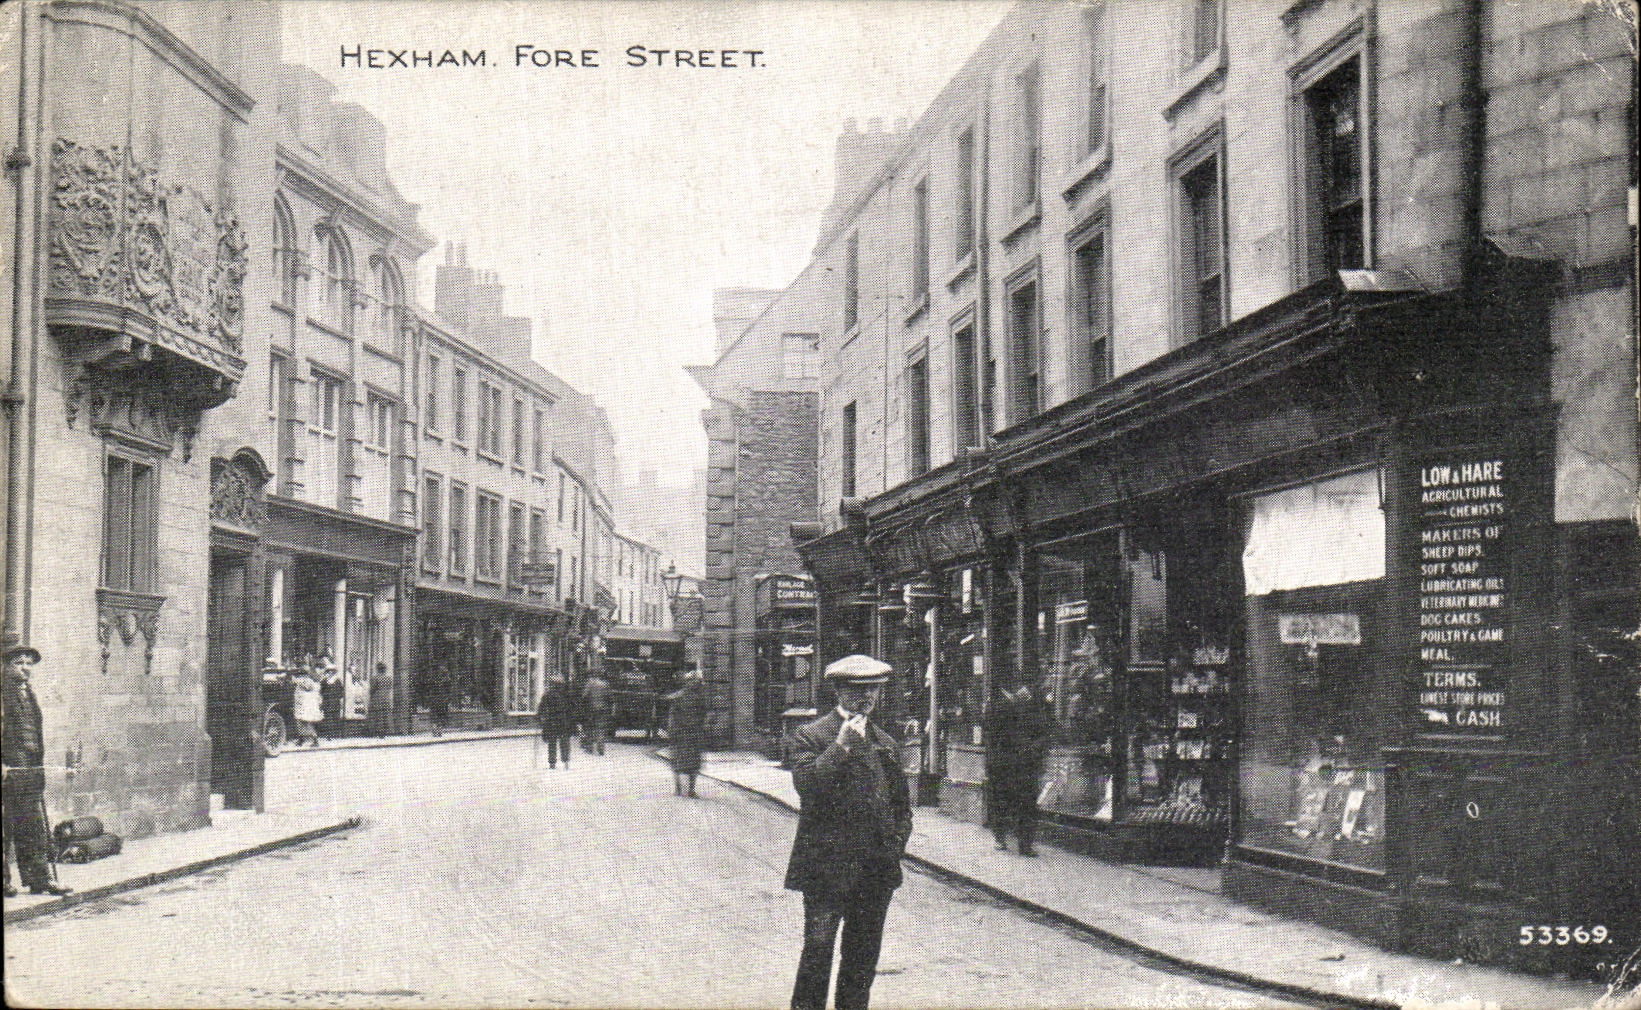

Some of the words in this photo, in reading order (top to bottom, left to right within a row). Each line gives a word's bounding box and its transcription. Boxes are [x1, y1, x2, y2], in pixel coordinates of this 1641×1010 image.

[1421, 466, 1451, 487] LOW
[1452, 470, 1460, 484] &
[1461, 461, 1504, 483] HARE
[1421, 485, 1504, 503] AGRICULTURAL
[1449, 503, 1504, 518] CHEMISTS
[1422, 527, 1482, 543] MAKERS
[1485, 525, 1504, 539] OF
[1421, 546, 1455, 559] SHEEP
[1421, 563, 1446, 576] SOFT
[1450, 561, 1480, 574] SOAP
[1420, 578, 1483, 592] LUBRICATING
[1420, 613, 1442, 626] DOG
[1444, 612, 1481, 625] CAKES
[1420, 630, 1469, 643] POULTRY
[1477, 628, 1504, 642] GAME
[1423, 671, 1482, 688] TERMS.
